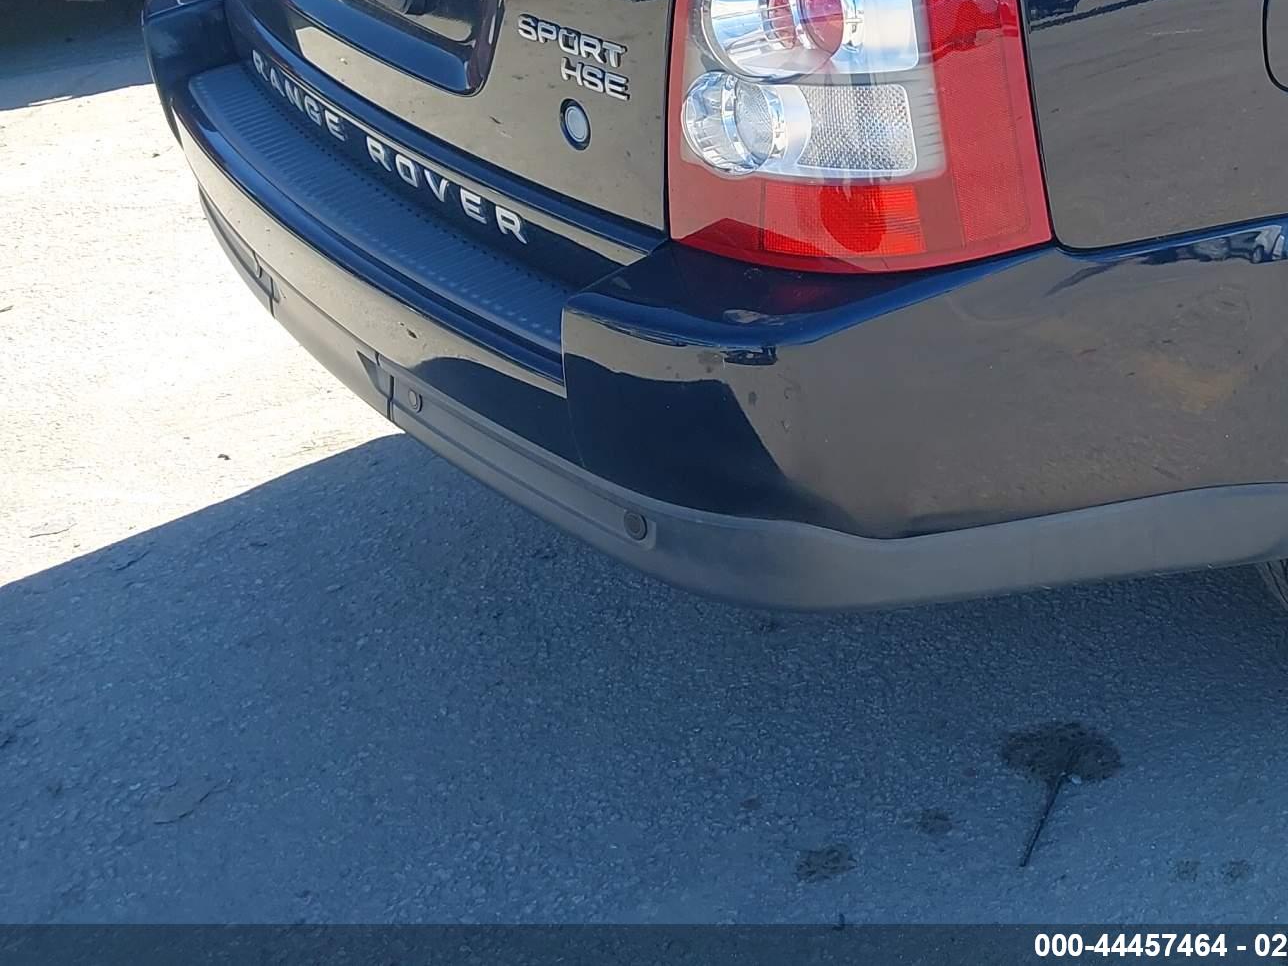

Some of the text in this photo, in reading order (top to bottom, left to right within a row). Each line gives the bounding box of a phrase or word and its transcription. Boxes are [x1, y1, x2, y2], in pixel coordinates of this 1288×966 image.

[518, 14, 628, 68] SPORT
[560, 56, 630, 101] HSE
[252, 49, 528, 245] RANGE ROVER
